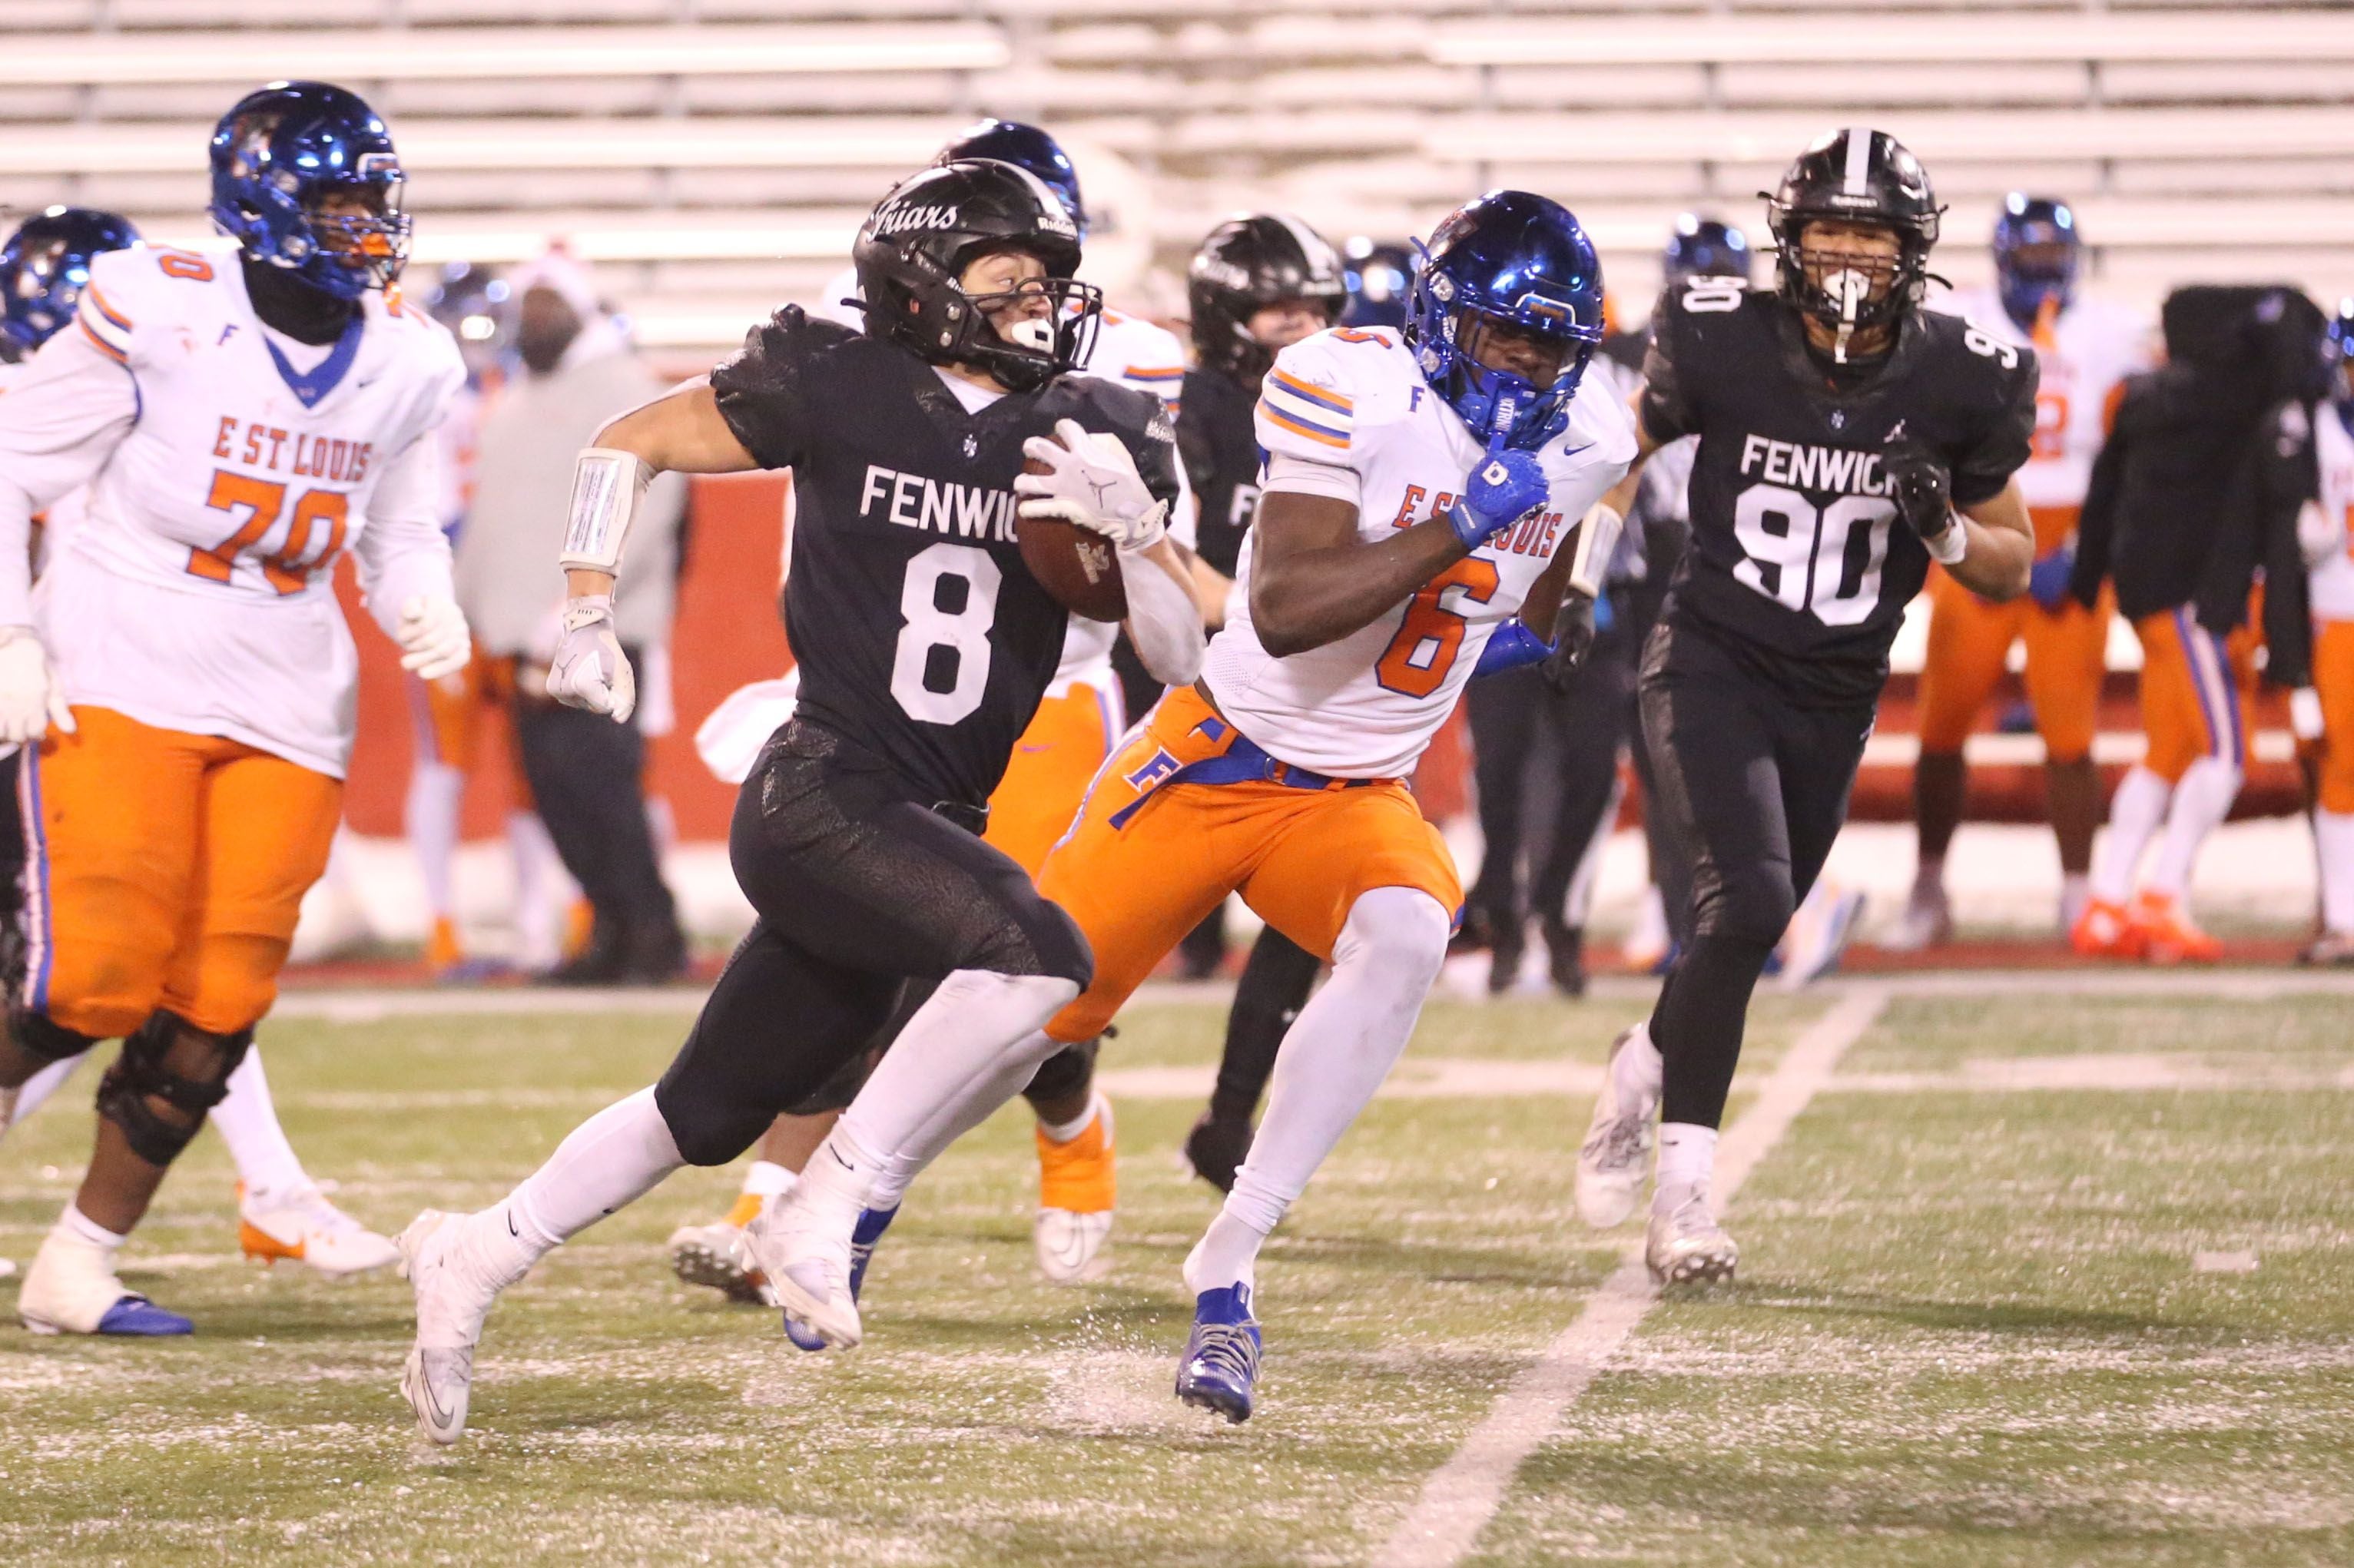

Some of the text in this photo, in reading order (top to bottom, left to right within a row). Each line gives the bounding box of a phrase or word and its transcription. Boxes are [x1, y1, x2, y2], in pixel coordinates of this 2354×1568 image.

[867, 197, 957, 243] Friars
[1407, 385, 1425, 413] F
[213, 416, 373, 482] E ST LOUIS
[185, 468, 349, 597] 70
[1391, 484, 1427, 529] E
[1732, 482, 1899, 628] 90
[890, 542, 1003, 726] 8
[1374, 555, 1500, 700] 6
